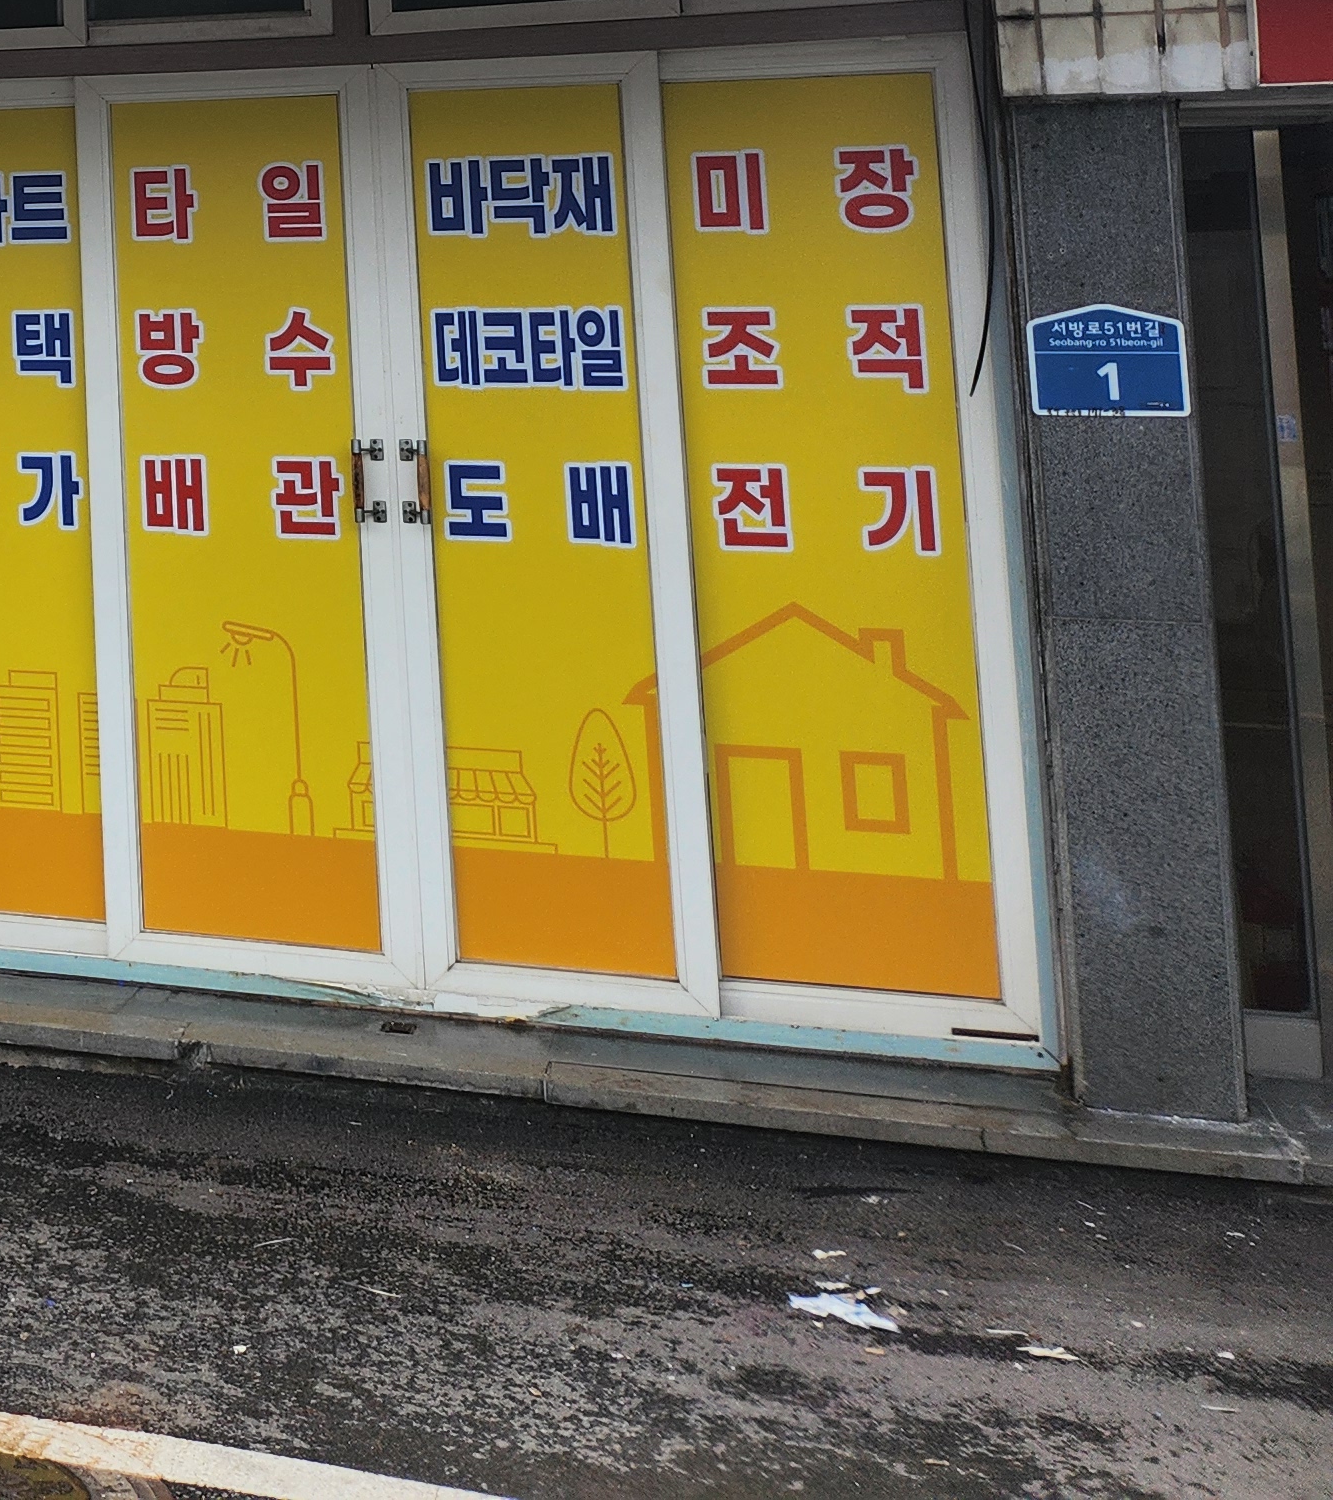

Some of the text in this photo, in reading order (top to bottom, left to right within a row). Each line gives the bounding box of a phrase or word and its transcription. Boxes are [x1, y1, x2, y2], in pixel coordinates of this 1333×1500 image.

[425, 152, 618, 238] 바닥재
[431, 305, 628, 392] 데코타일
[1048, 337, 1164, 348] Seobang-ro 51beon-gil
[1050, 320, 1161, 338] 서방로51번길
[1096, 361, 1121, 401] 1
